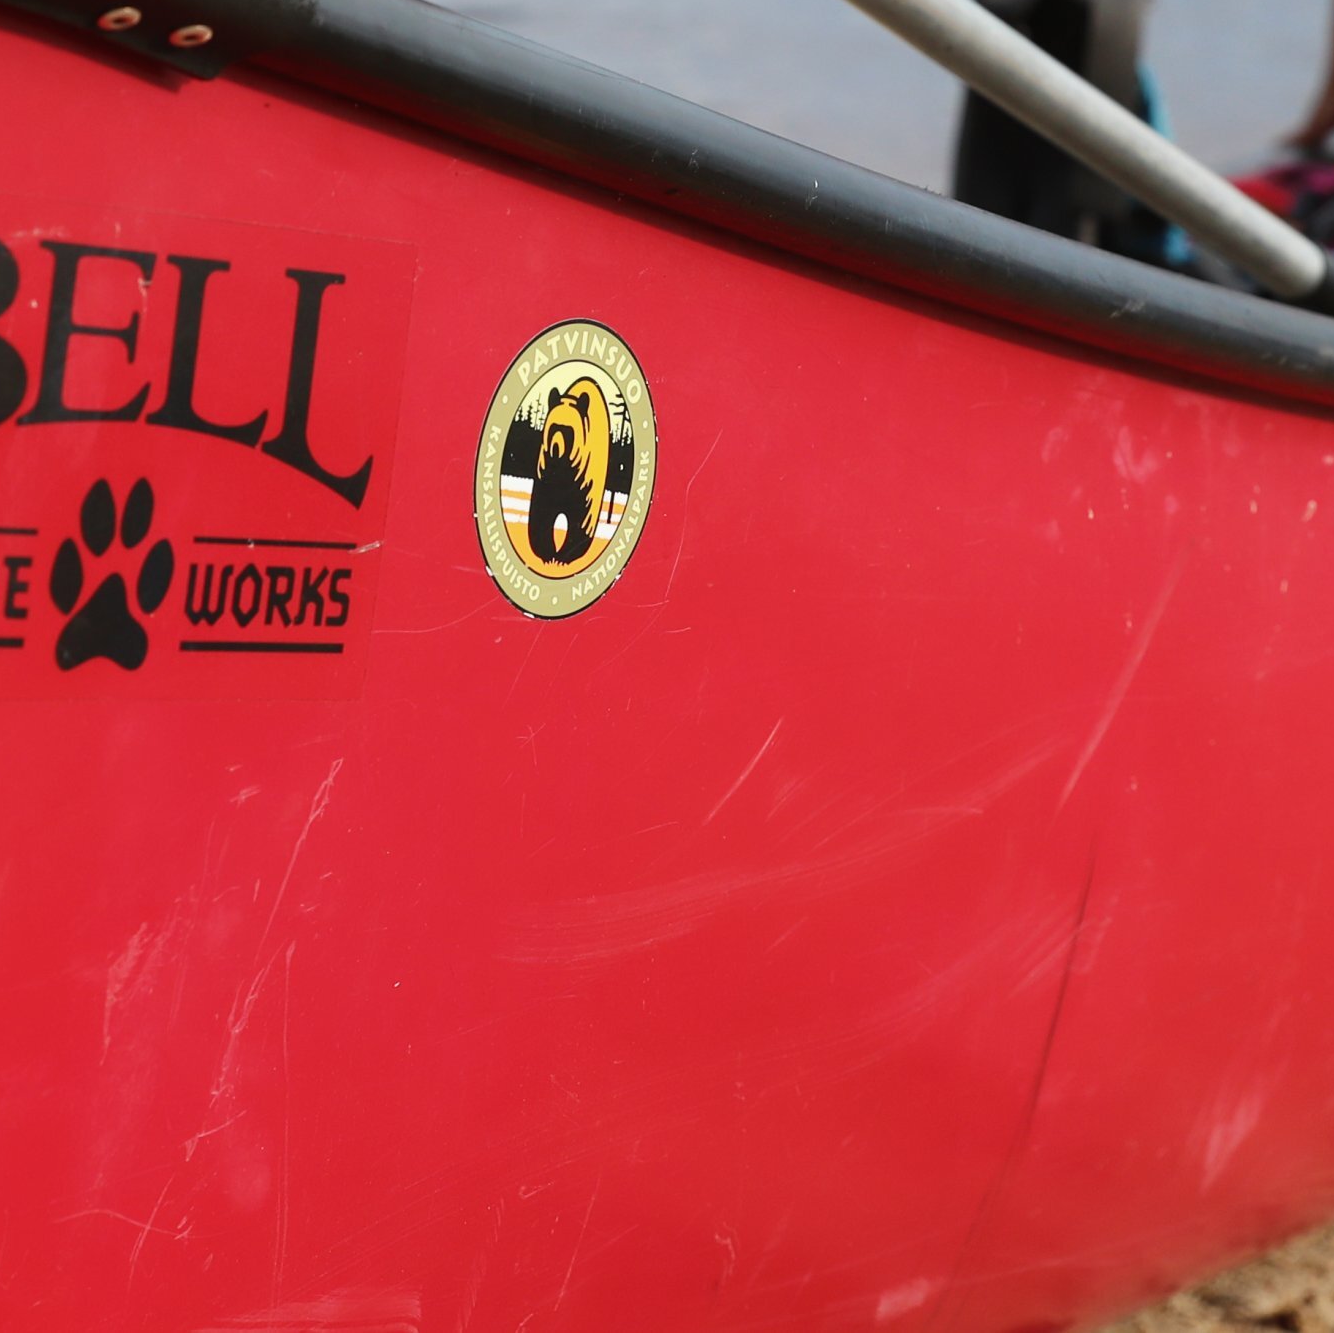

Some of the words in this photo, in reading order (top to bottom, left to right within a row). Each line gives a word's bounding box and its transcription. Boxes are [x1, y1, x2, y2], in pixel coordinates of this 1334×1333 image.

[517, 330, 642, 405] PATVINSUO
[482, 425, 540, 601] KANSALLISPUISTO
[571, 450, 650, 601] NATIONALPARK
[183, 562, 352, 628] WORKS
